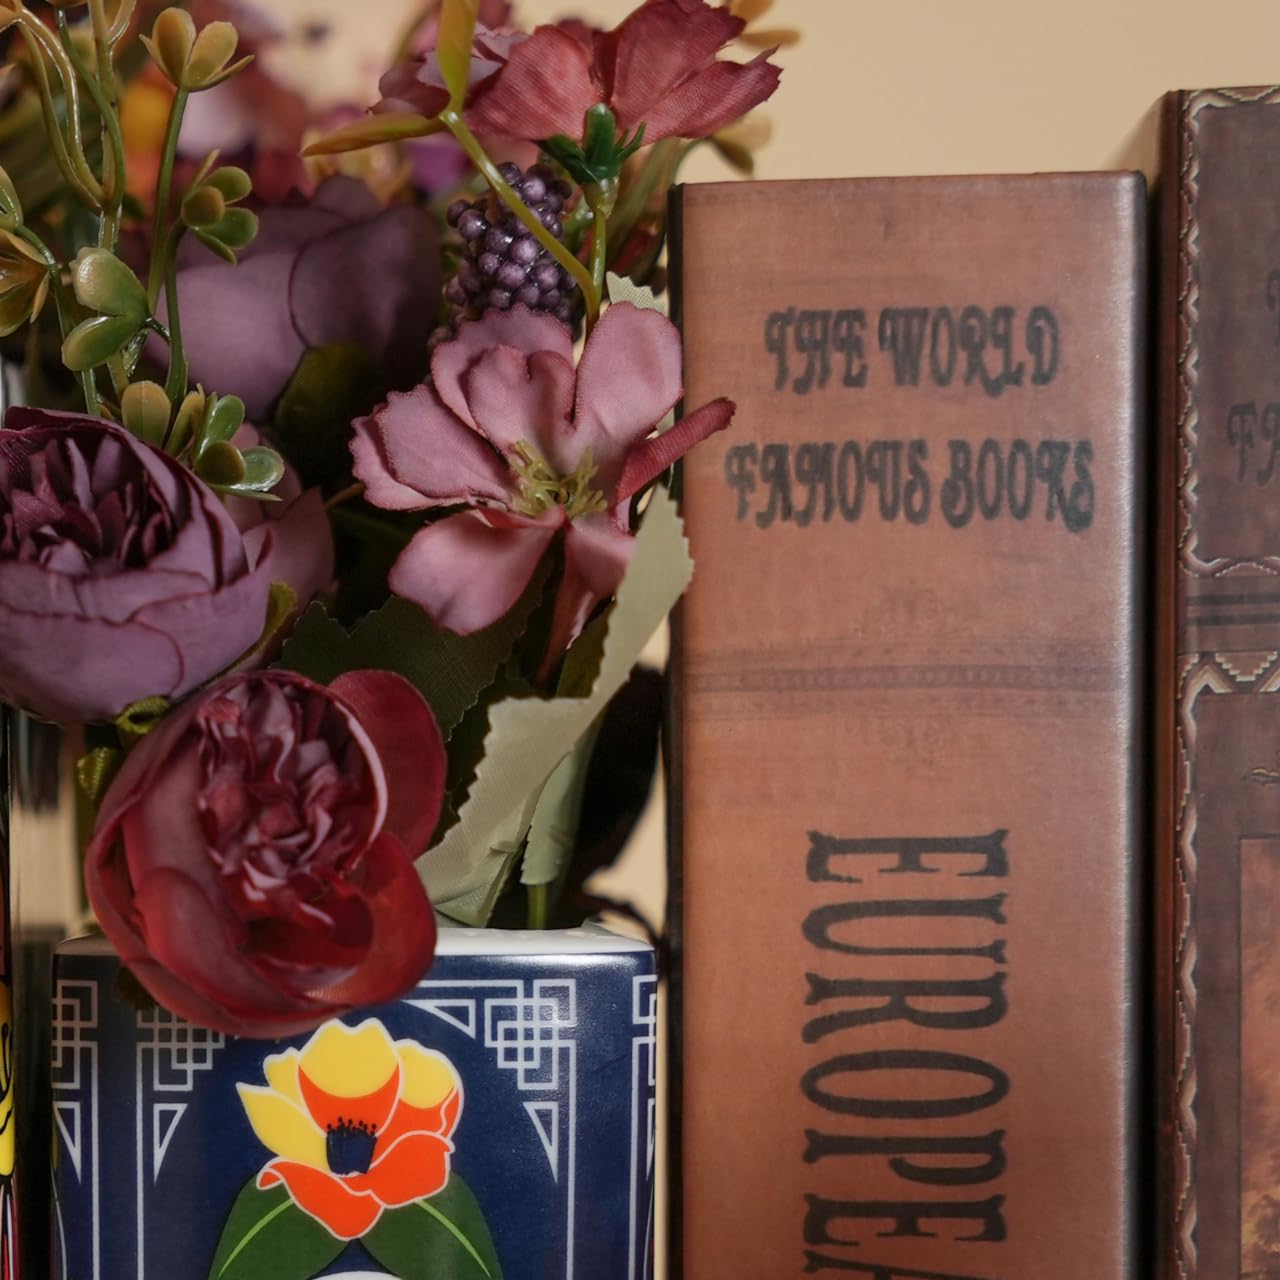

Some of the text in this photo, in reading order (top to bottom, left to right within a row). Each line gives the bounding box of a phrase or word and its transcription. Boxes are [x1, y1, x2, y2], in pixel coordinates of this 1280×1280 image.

[764, 304, 1061, 398] THE WORLD
[724, 437, 1096, 534] FAMOUS BOOKS
